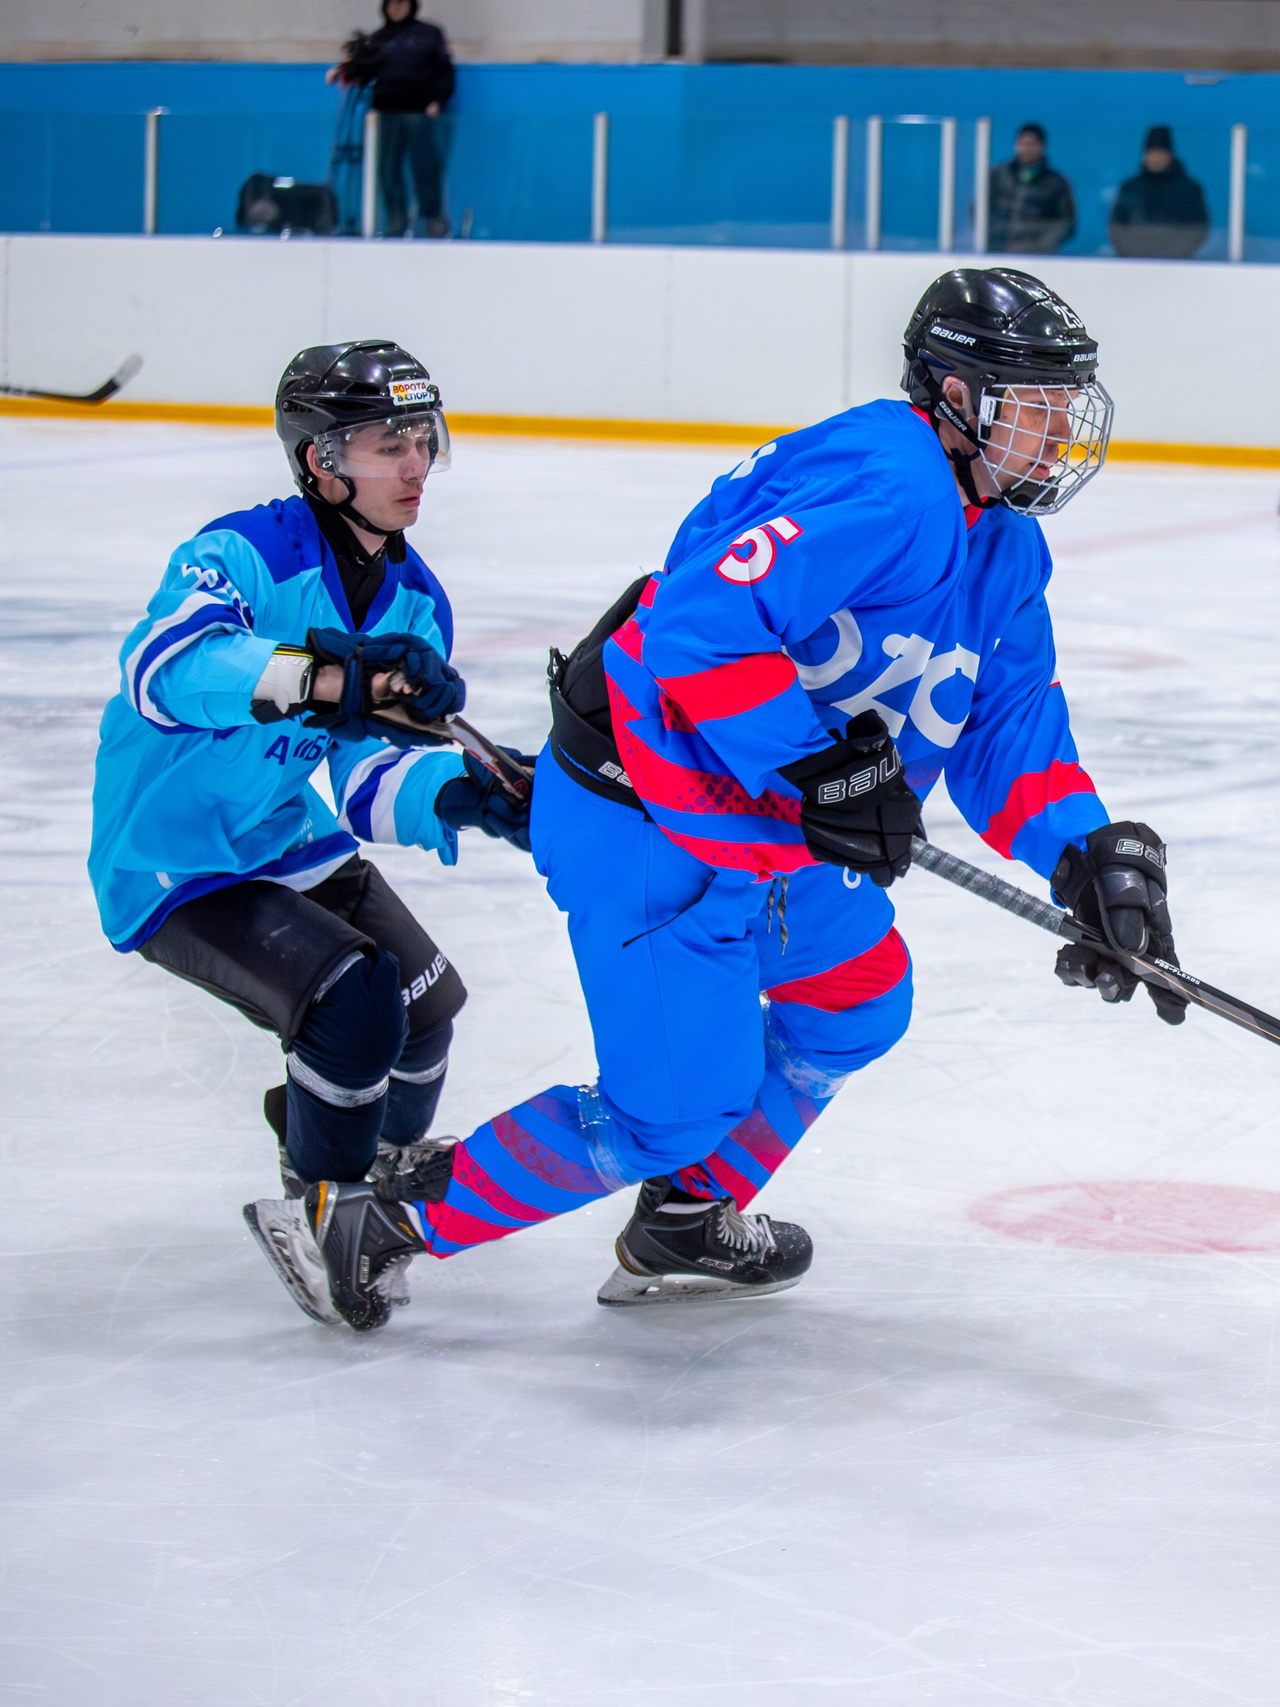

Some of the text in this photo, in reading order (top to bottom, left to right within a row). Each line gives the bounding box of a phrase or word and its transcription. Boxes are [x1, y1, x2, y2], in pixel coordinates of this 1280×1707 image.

[931, 325, 976, 347] BAUER
[392, 382, 426, 394] ВОРОТА
[397, 394, 404, 402] В
[939, 400, 967, 432] BAUER
[818, 745, 902, 804] BAU
